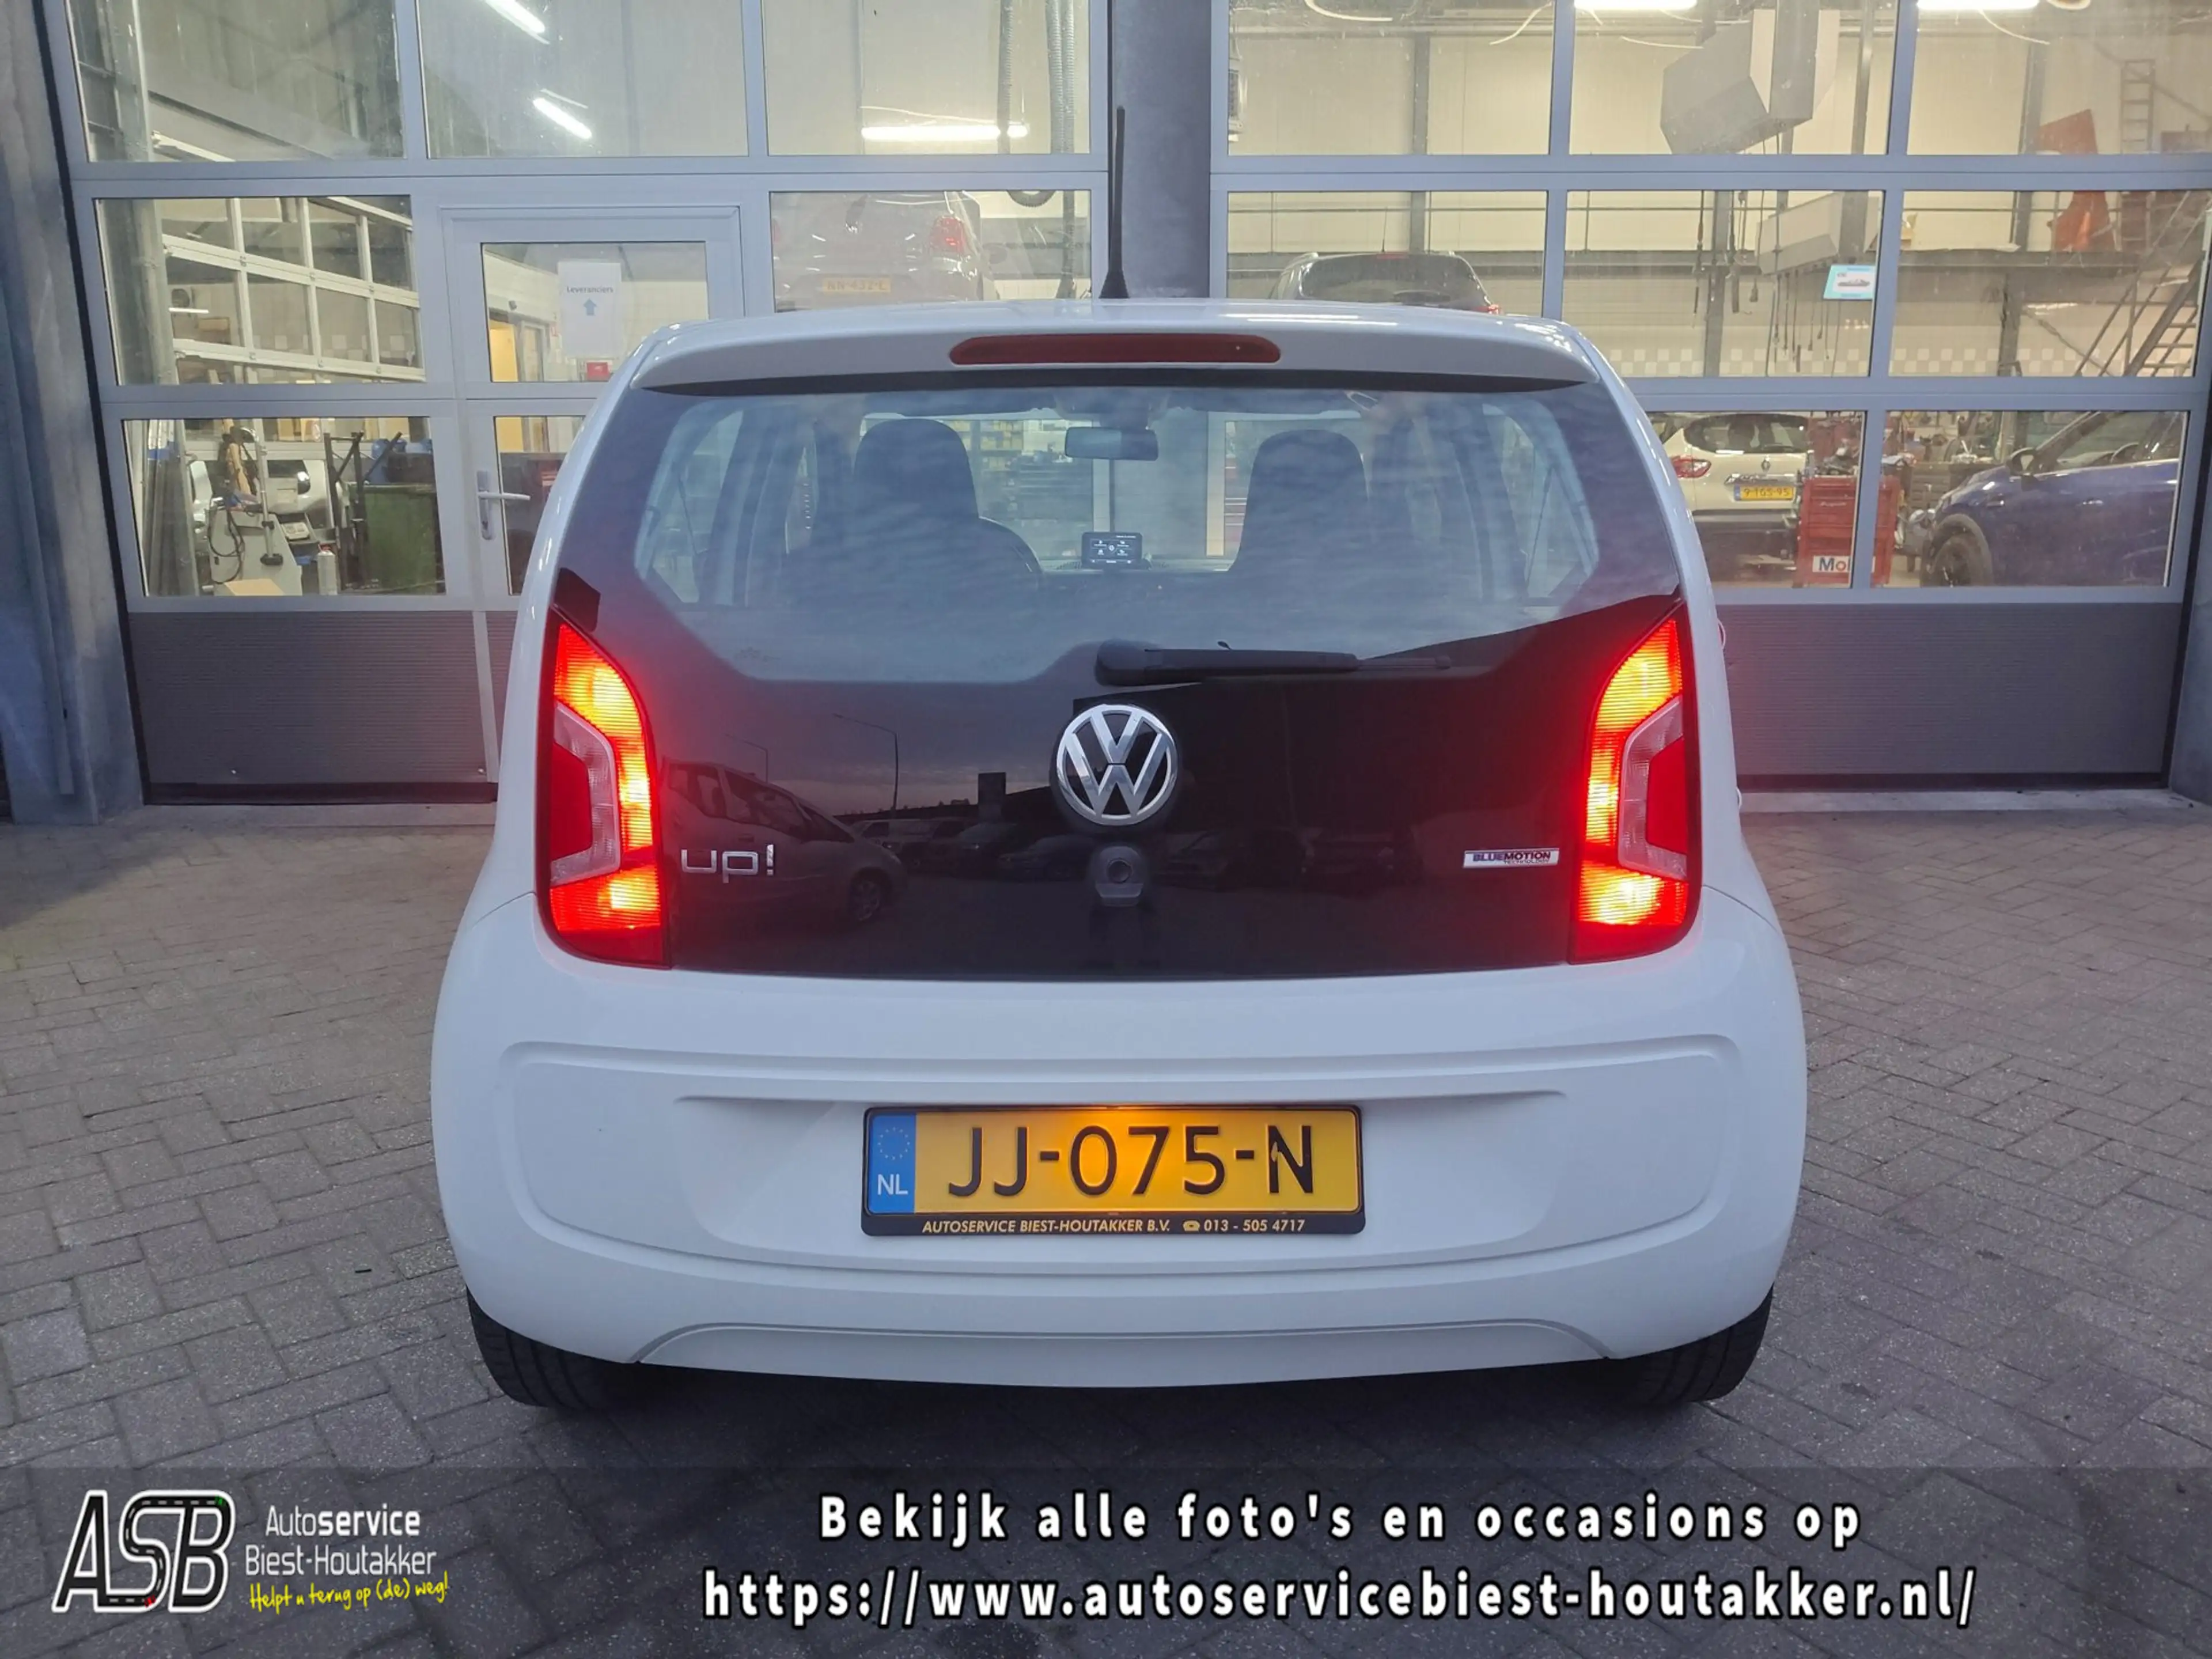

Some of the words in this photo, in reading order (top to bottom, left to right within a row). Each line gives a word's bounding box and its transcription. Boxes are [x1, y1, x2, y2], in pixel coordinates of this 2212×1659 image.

[680, 843, 775, 884] up!
[1472, 851, 1551, 862] BLUEMOTION
[948, 1124, 1314, 1198] JJ-075-N
[877, 1173, 909, 1196] NL
[922, 1220, 1016, 1233] AUTOSERVICE
[1020, 1219, 1143, 1233] BIEST-HOUTAKKER
[1147, 1219, 1171, 1232] B.V.
[1203, 1219, 1229, 1232] 013
[1243, 1219, 1268, 1232] 505
[1272, 1219, 1305, 1232] 4717
